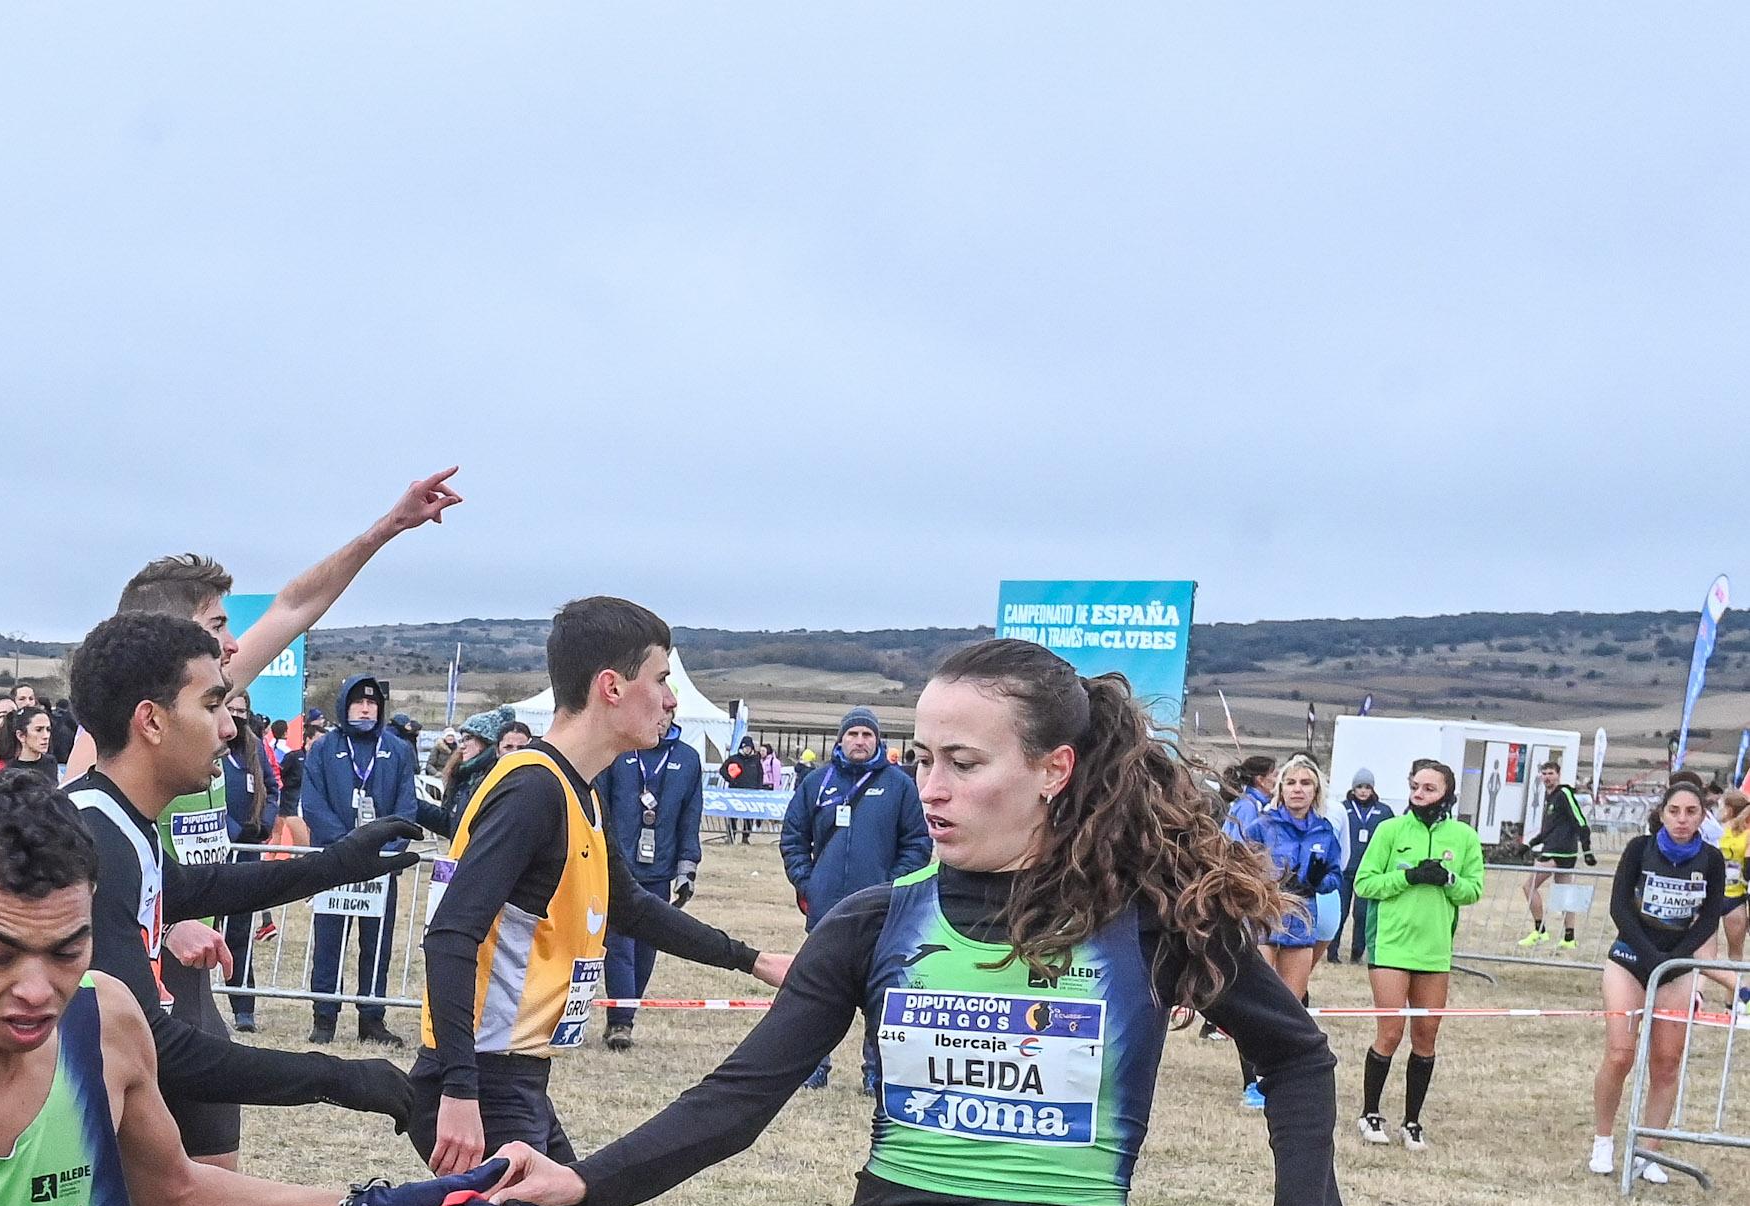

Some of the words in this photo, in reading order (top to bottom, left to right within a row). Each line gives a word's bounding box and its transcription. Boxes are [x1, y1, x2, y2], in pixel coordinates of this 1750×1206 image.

[1004, 604, 1073, 625] CAMPEONATO
[1075, 604, 1089, 624] DE
[1090, 601, 1180, 626] ESPAÑA
[1047, 625, 1084, 648] TRAVÉS
[1100, 630, 1177, 650] CLUBES
[328, 898, 370, 911] BURGOS
[905, 994, 1012, 1015] DIPUTACIÓN
[901, 1010, 1010, 1031] BURGOS
[881, 1030, 906, 1043] 216
[935, 1033, 1008, 1053] Ibercaja
[1088, 1045, 1097, 1057] 1
[928, 1056, 1044, 1095] LLEIDA
[937, 1094, 1074, 1137] Joma
[60, 1165, 90, 1183] ALEDE
